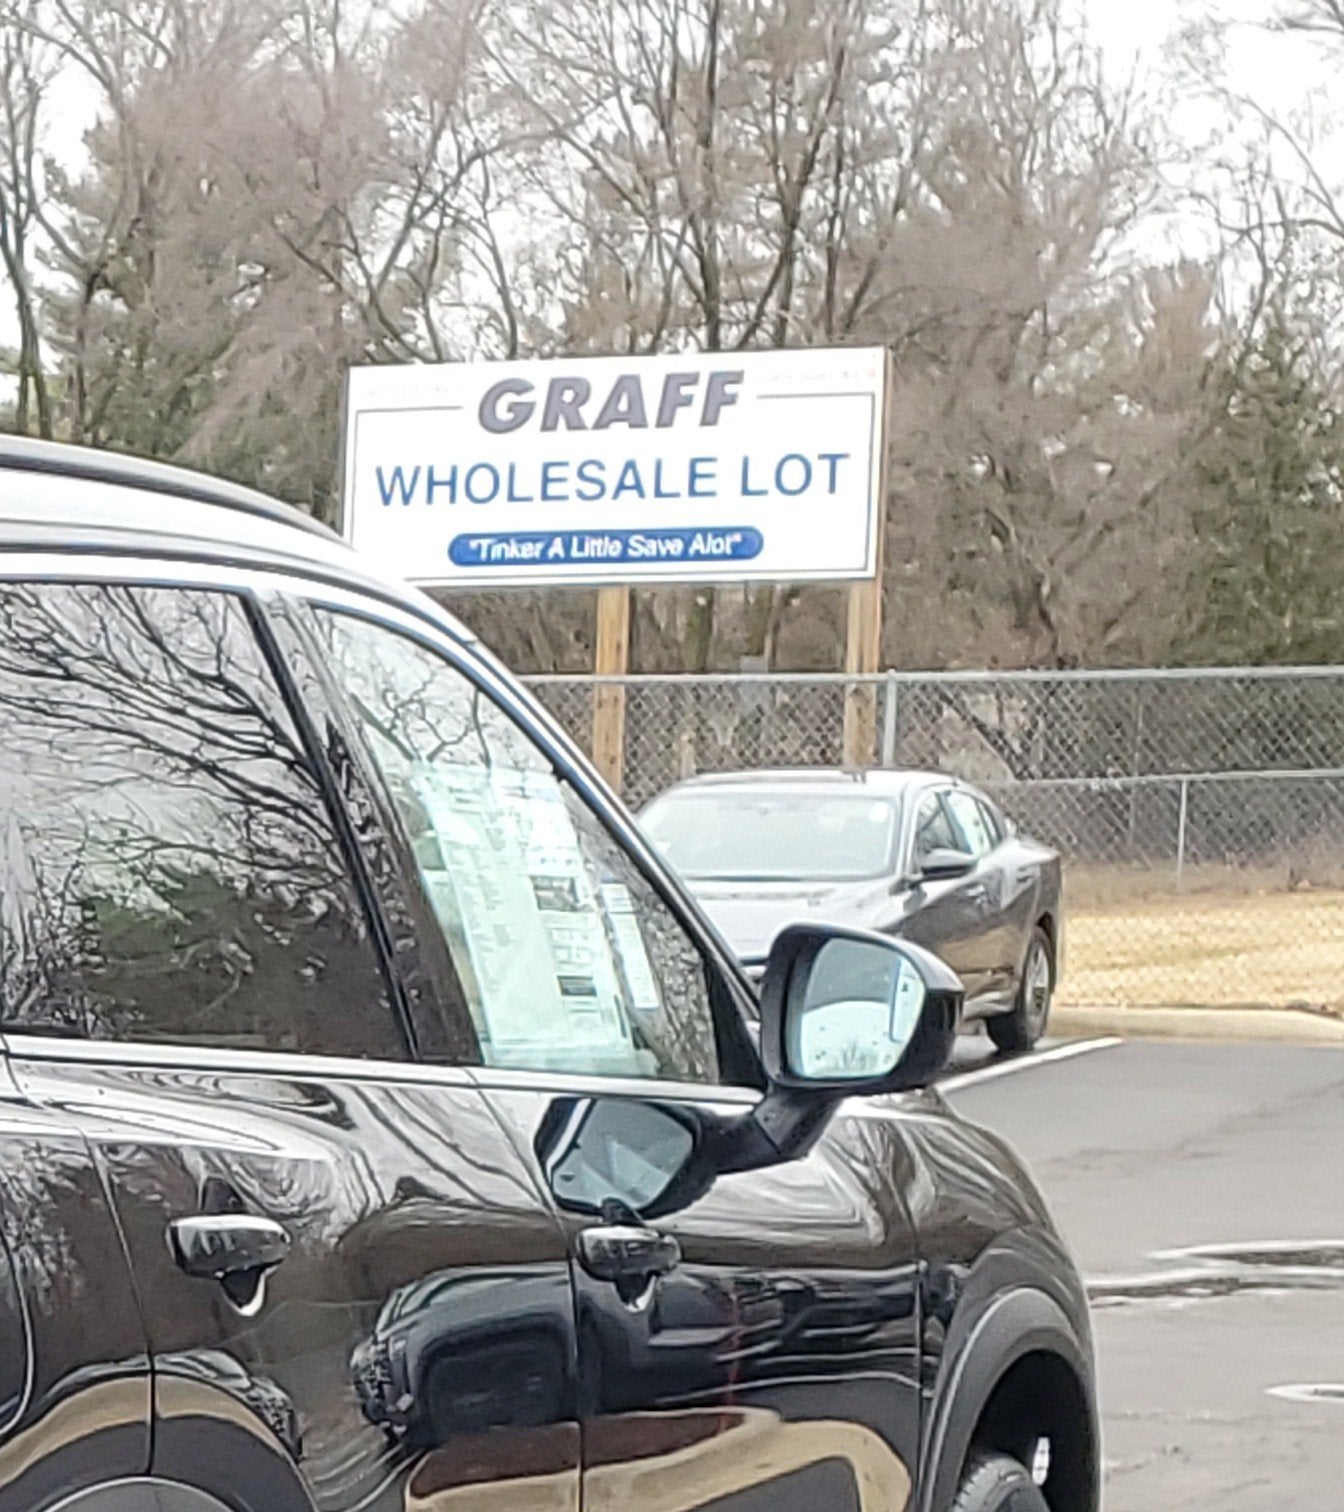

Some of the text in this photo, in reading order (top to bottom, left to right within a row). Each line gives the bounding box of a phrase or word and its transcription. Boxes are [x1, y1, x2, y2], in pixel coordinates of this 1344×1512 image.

[478, 369, 744, 434] GRAFF
[376, 453, 850, 506] WHOLESALE LOT
[548, 537, 565, 558] A
[571, 535, 621, 557] Little
[628, 536, 683, 557] Save
